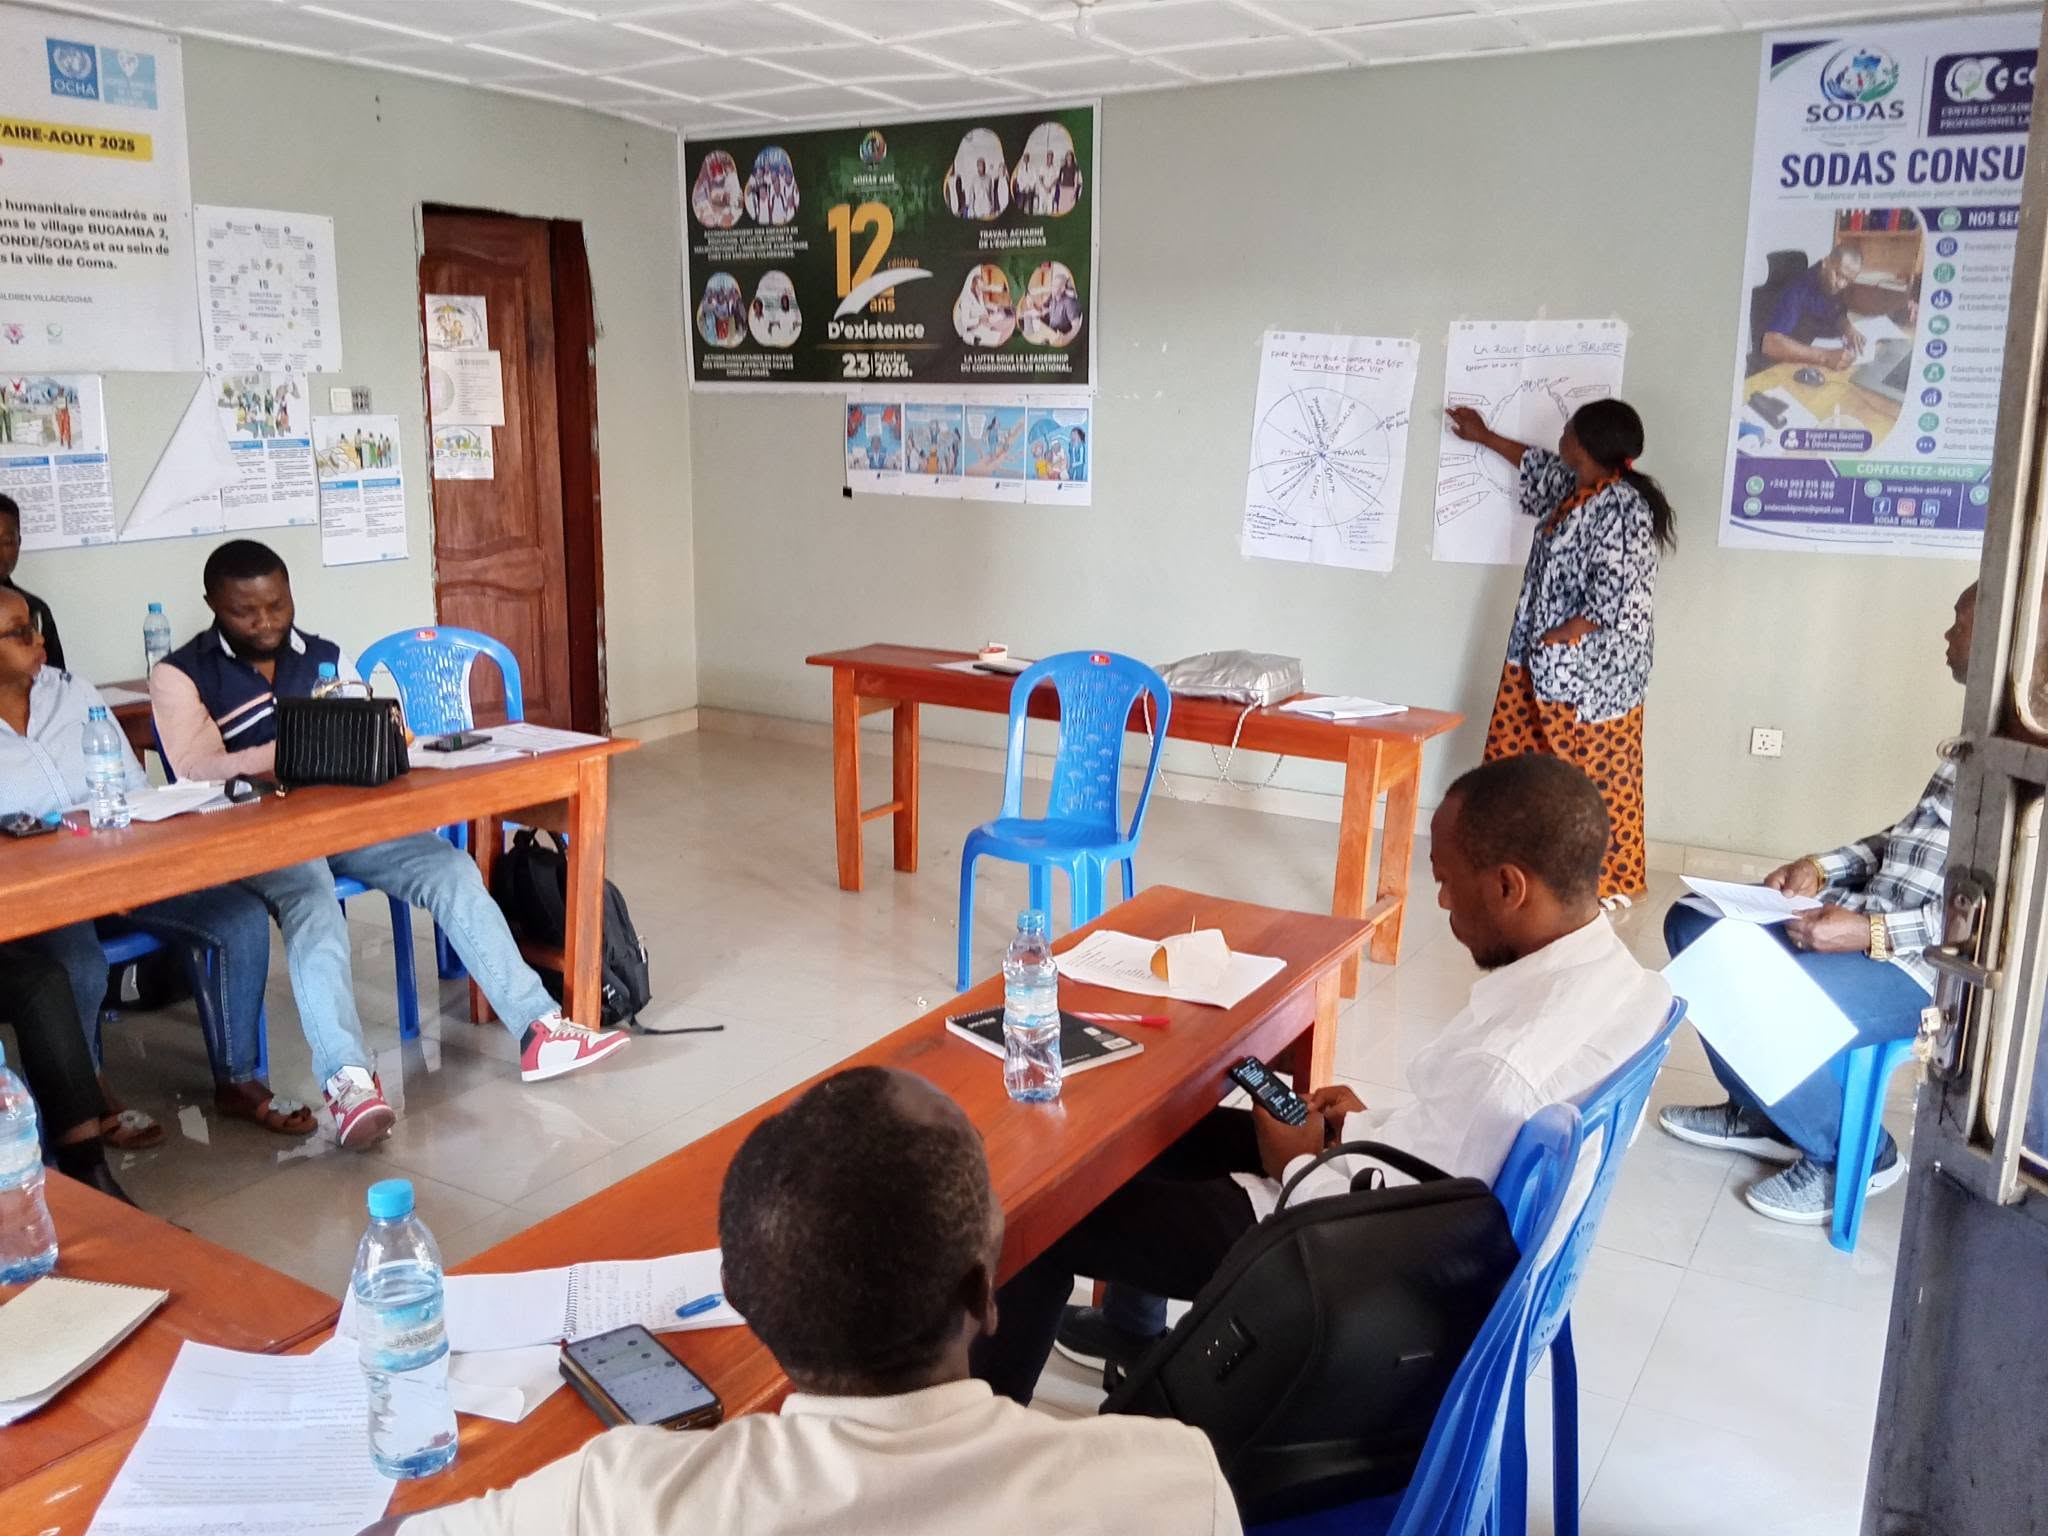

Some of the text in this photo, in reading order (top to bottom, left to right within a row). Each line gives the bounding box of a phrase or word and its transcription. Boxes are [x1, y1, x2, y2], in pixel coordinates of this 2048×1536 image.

[54, 79, 96, 97] OCHA
[1806, 100, 1905, 123] SODAS
[100, 135, 136, 152] 2025
[1780, 144, 2026, 188] SODAS CONSU
[5, 199, 168, 223] humanitaire encadrés au
[1968, 211, 1995, 227] NOS
[24, 218, 36, 230] le
[41, 219, 84, 235] village
[159, 228, 168, 241] 2,
[980, 229, 1008, 240] TRAVAIL
[93, 240, 105, 253] et
[108, 244, 125, 253] au
[127, 242, 153, 255] sein
[156, 244, 169, 256] de
[827, 202, 895, 299] 12
[978, 239, 988, 249] DE
[11, 252, 23, 264] la
[26, 253, 53, 266] ville
[57, 255, 73, 267] de
[76, 257, 117, 270] Goma.
[869, 298, 897, 313] ans
[828, 319, 926, 340] D'existence
[1473, 343, 1488, 355] LA
[1493, 342, 1517, 354] ROUE
[1555, 342, 1574, 352] VIE
[842, 352, 871, 378] 23
[964, 354, 973, 363] LA
[1015, 353, 1024, 363] LE
[1025, 353, 1069, 363] LEADERSHIP
[1333, 448, 1368, 457] TRAVAIL
[1856, 463, 1975, 479] CONTACTEZ-NOUS
[1873, 516, 1899, 526] SODAS
[1900, 517, 1918, 526] ONG
